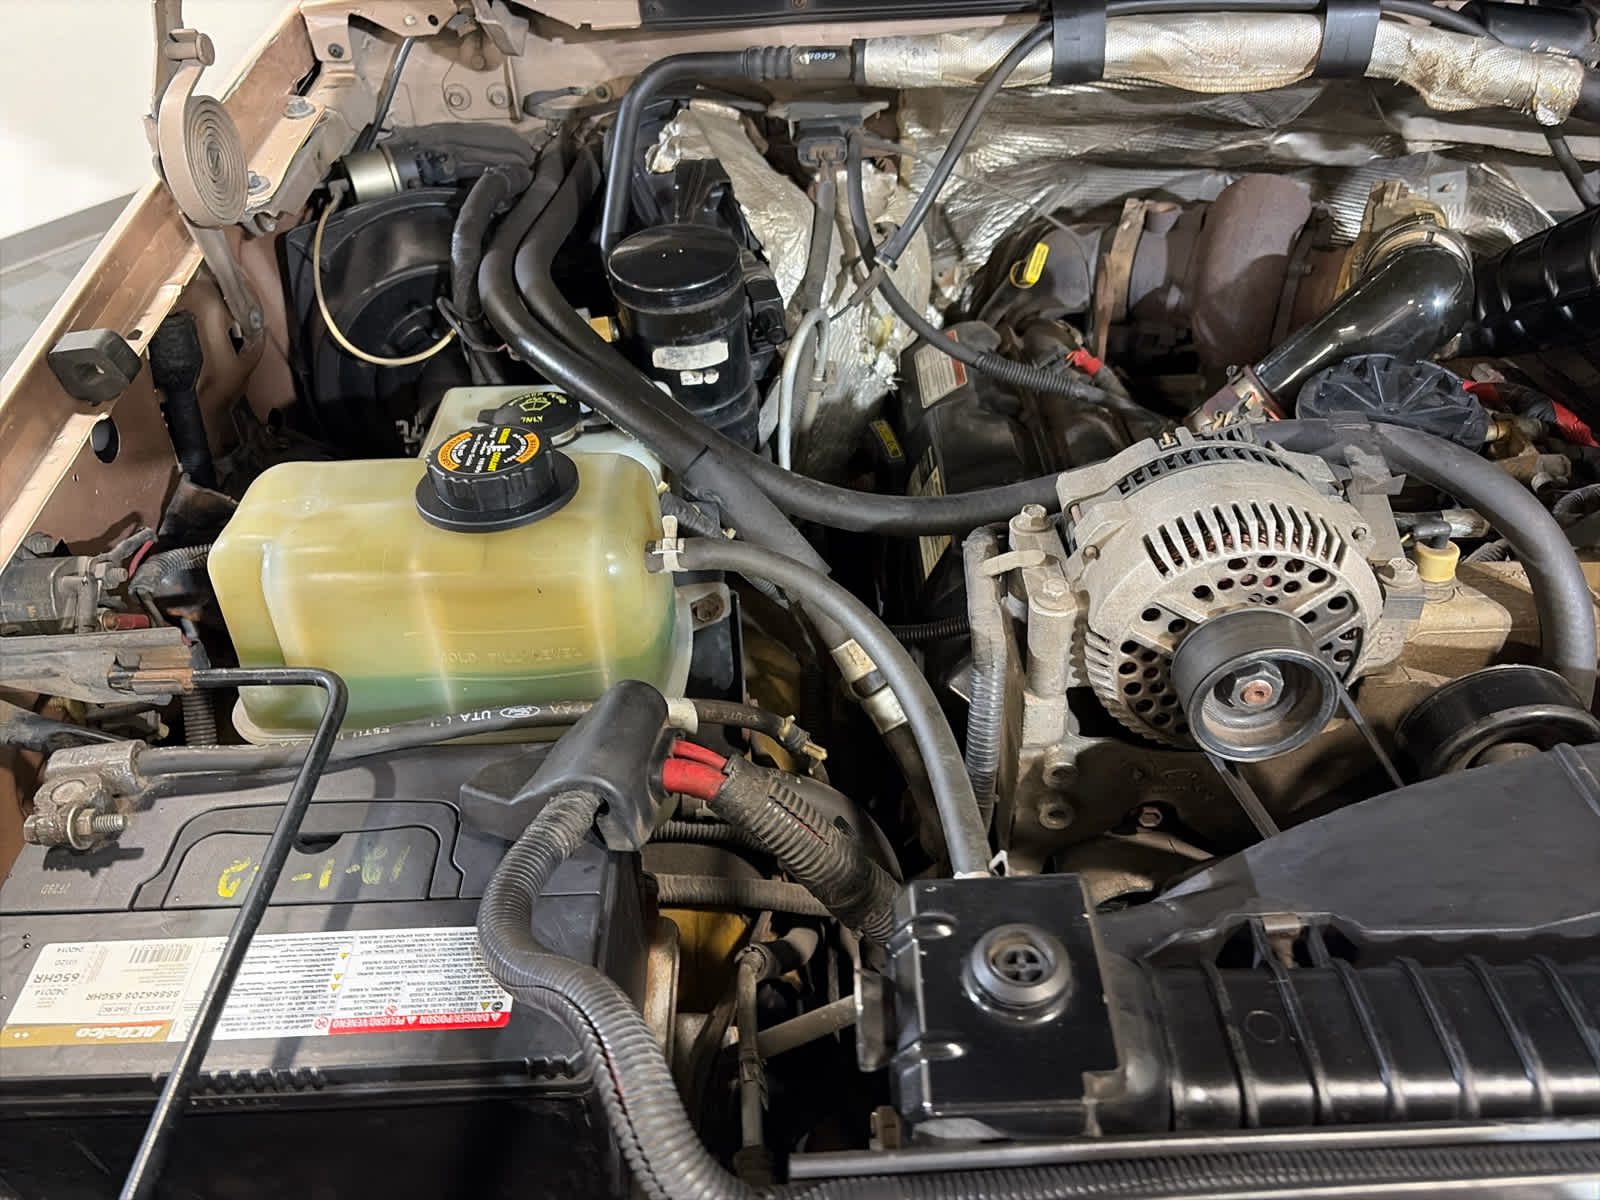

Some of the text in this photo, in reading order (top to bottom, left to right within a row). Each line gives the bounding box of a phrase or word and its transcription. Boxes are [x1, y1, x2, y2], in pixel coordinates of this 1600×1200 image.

[460, 710, 491, 722] UTA
[33, 972, 80, 984] 65GHR
[76, 1026, 163, 1039] ACDelco
